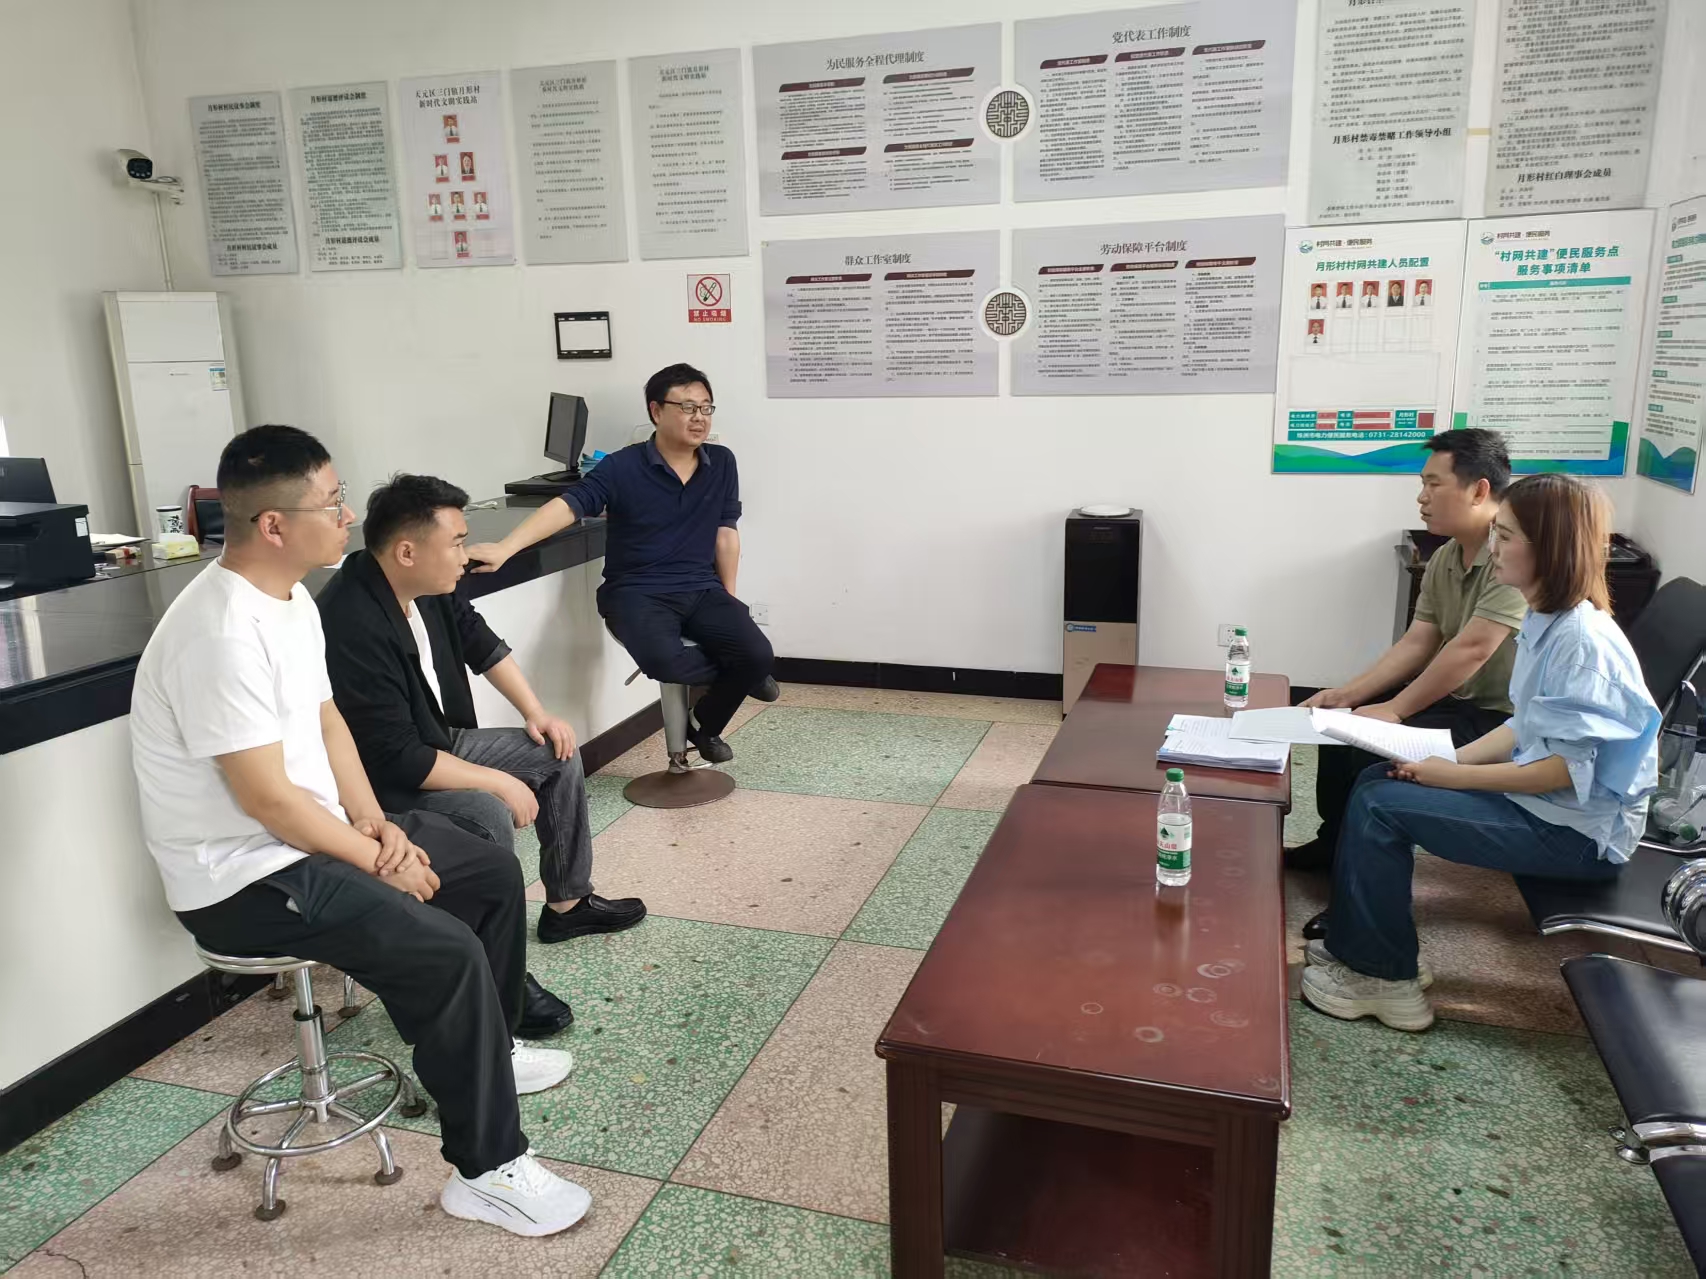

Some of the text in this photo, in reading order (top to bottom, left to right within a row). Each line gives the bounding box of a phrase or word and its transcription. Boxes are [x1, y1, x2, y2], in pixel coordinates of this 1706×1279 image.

[1112, 25, 1191, 44] 党代表工作制度
[826, 51, 925, 71] 为民服务全程代理制度
[416, 85, 480, 98] 天元区三门镇月形村
[419, 95, 478, 108] 新时代文明实践站
[1333, 128, 1452, 144] 月形村禁毒禁赌工作领导小组
[1518, 168, 1611, 183] 月形村红白理事会成员
[1100, 240, 1188, 255] 劳动保障平台制度
[844, 253, 911, 266] 群众工作室制度
[1316, 257, 1430, 272] 月形村村网共建人员配置
[1516, 262, 1592, 276] 服务事项清单
